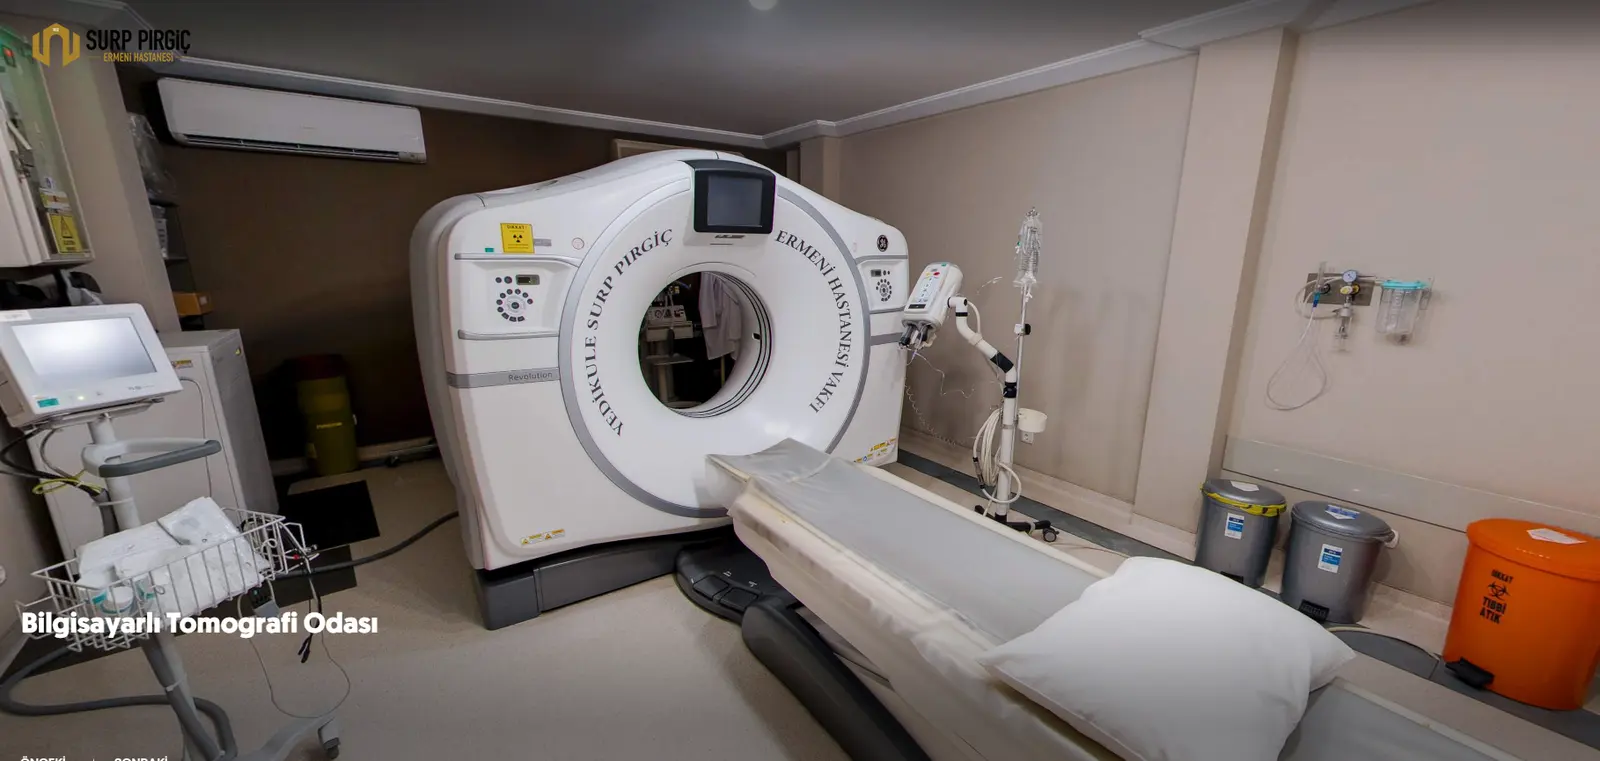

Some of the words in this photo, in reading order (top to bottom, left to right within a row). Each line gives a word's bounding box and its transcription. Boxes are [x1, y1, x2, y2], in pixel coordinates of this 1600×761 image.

[614, 228, 673, 276] PIRGİÇ
[775, 229, 836, 277] ERMENİ
[587, 276, 613, 331] SURP
[828, 276, 852, 369] HASTANESİ
[508, 372, 553, 381] Revolution
[584, 336, 624, 437] YEDİKULE
[809, 371, 844, 414] VAKFI
